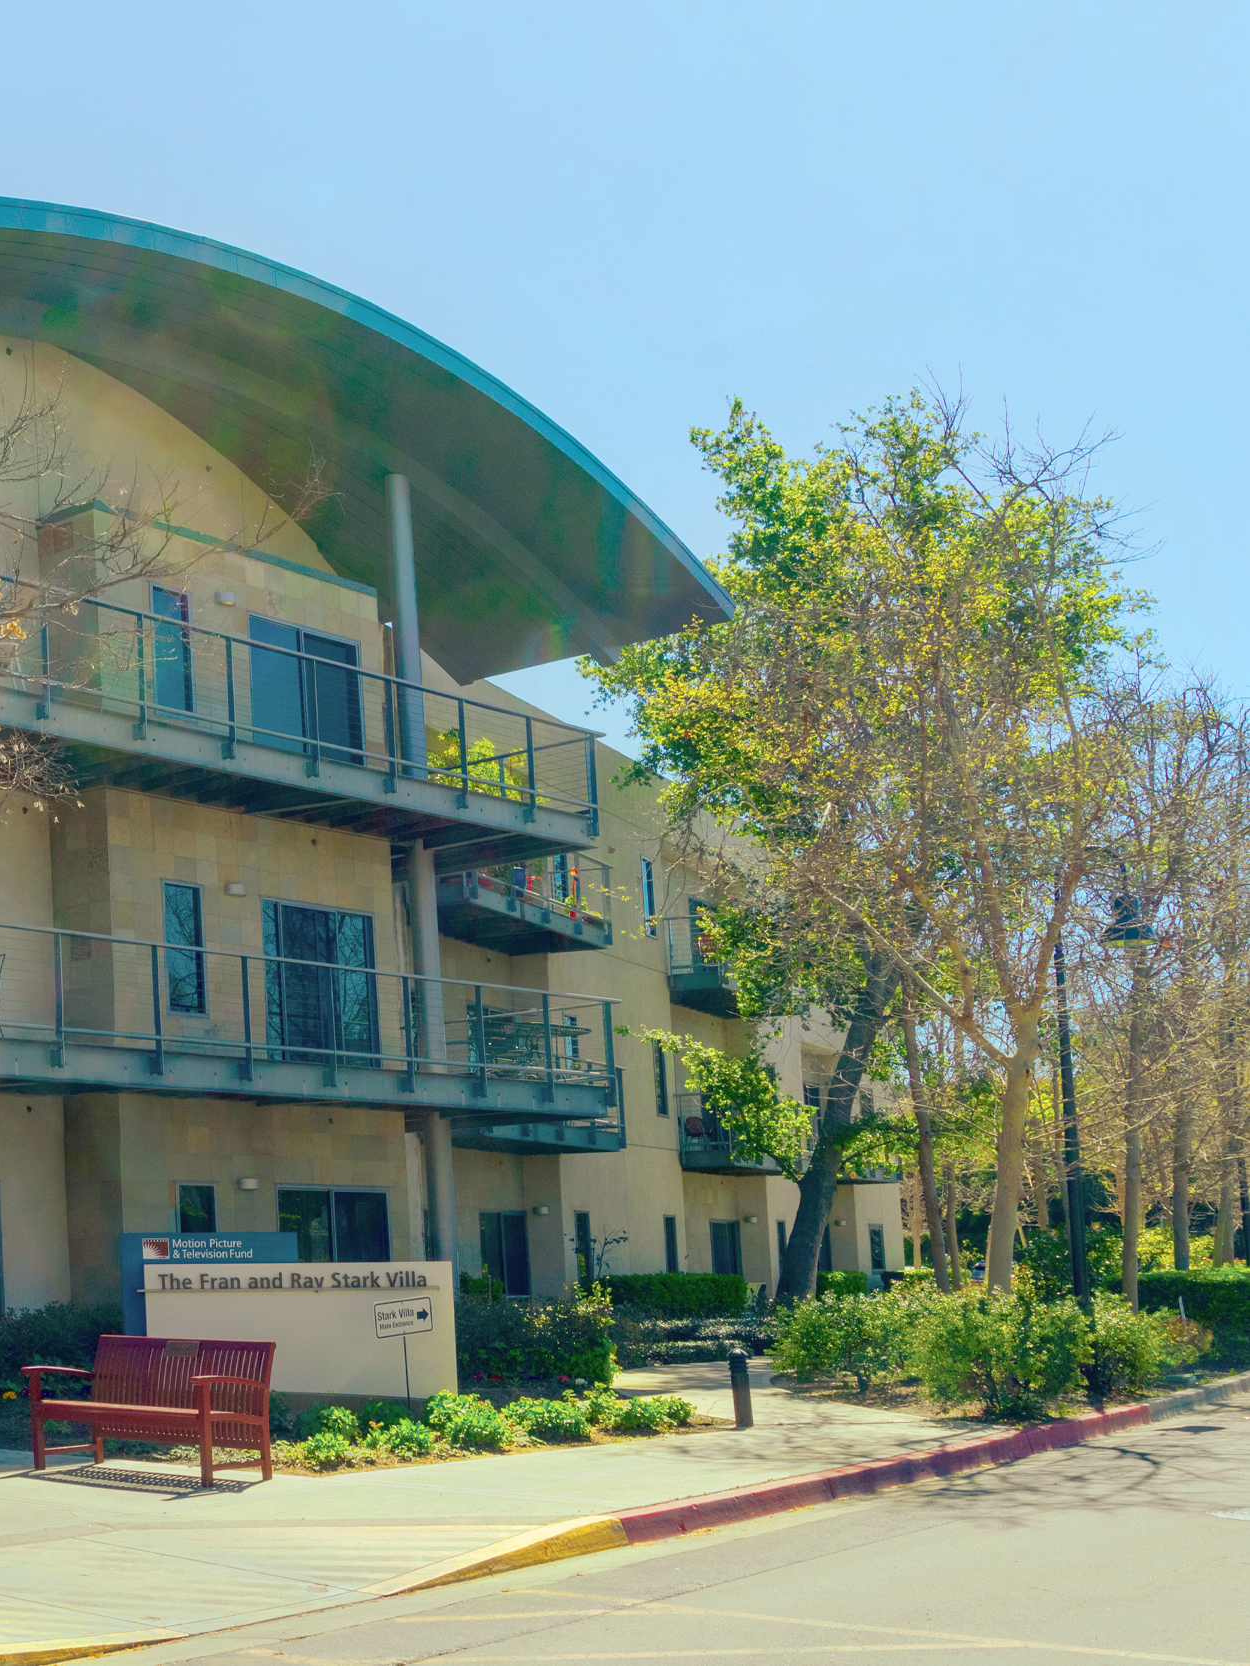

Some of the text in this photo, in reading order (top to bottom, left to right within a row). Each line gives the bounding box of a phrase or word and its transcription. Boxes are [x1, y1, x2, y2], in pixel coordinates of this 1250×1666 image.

[172, 1238, 243, 1249] Motion Picture
[172, 1248, 253, 1259] & Television Fund
[158, 1271, 428, 1292] The Fran and Ray Stark Villa
[377, 1308, 414, 1321] Stark Villa
[392, 1320, 414, 1328] Entrance
